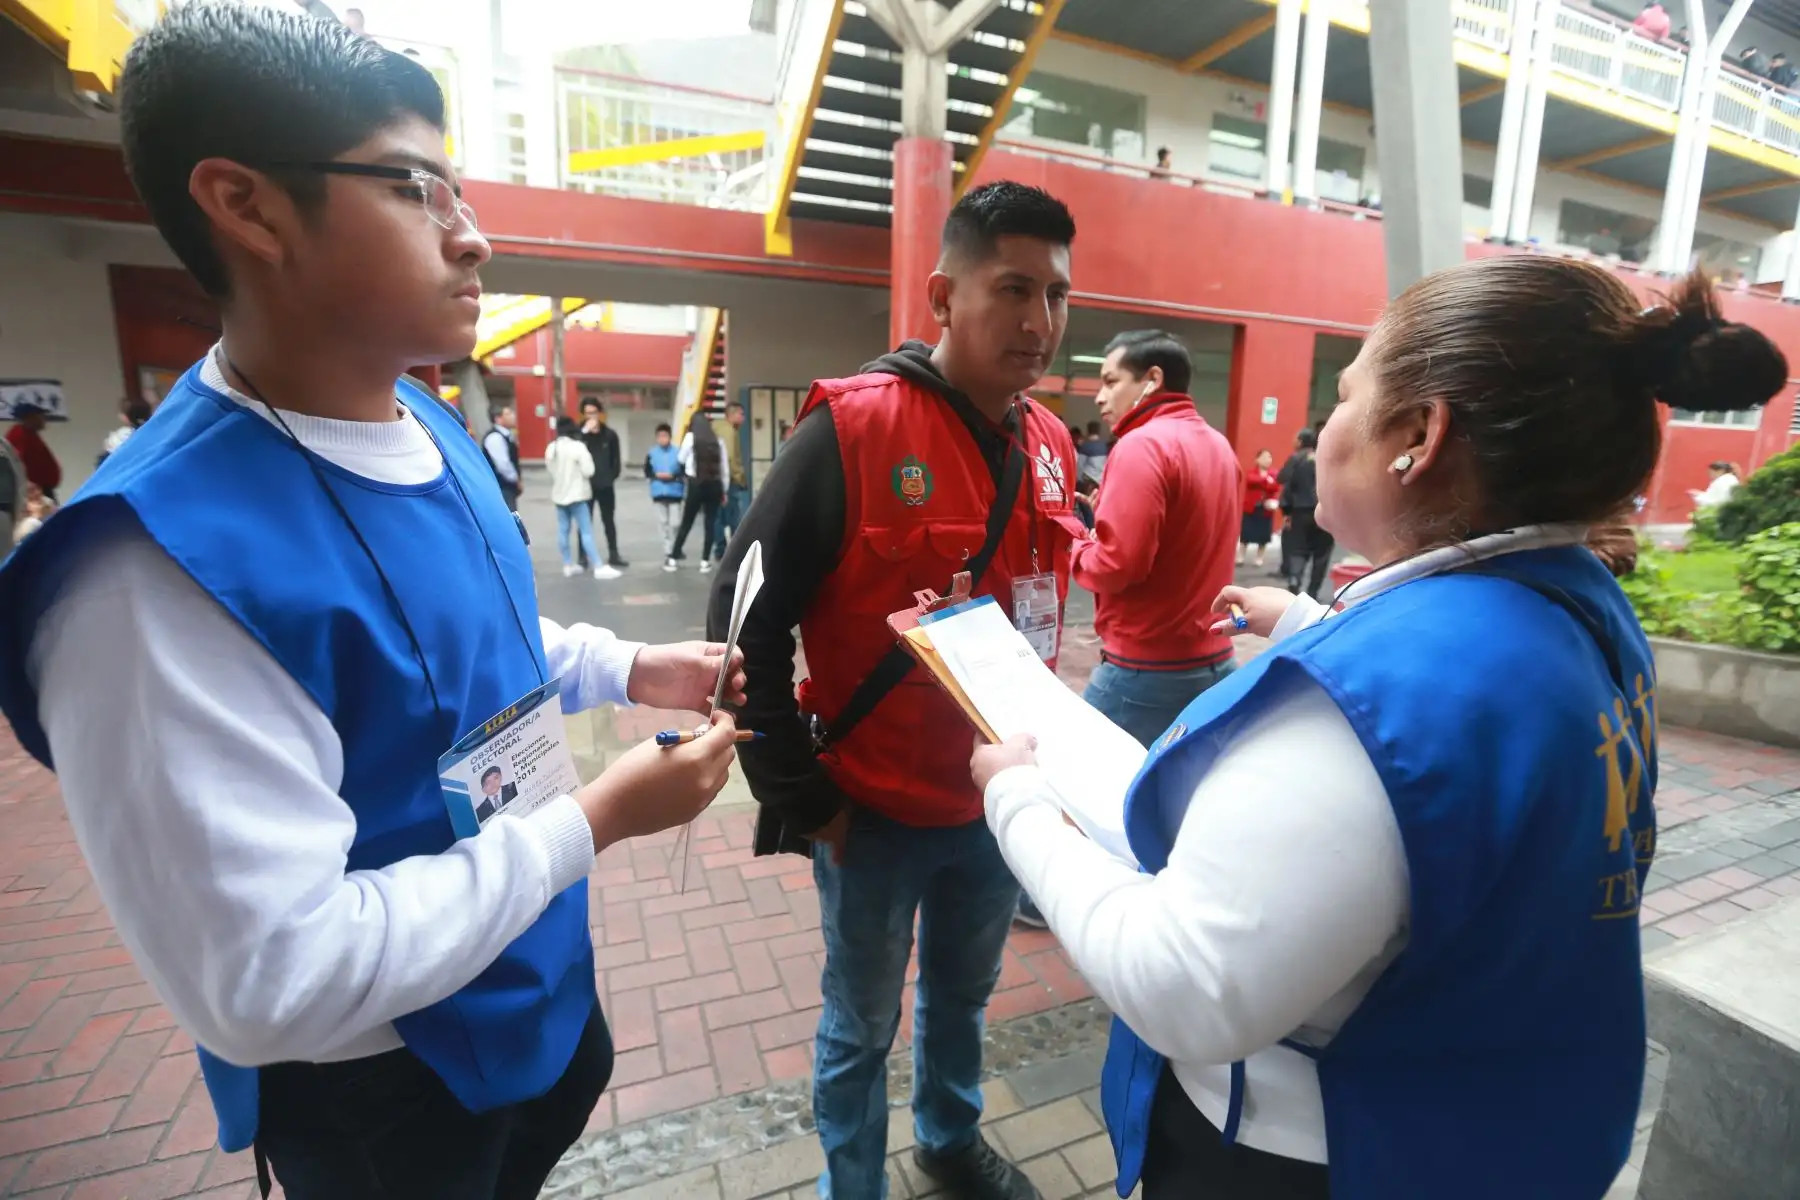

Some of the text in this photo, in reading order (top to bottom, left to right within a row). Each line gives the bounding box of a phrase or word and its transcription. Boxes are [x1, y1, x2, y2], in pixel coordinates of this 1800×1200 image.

[470, 711, 541, 765] OBSERVADOR/A
[511, 734, 546, 762] Elecciones
[472, 735, 522, 774] ELECTORAL
[512, 739, 549, 769] Regionales
[520, 740, 560, 772] Municipales
[516, 765, 537, 784] 2018
